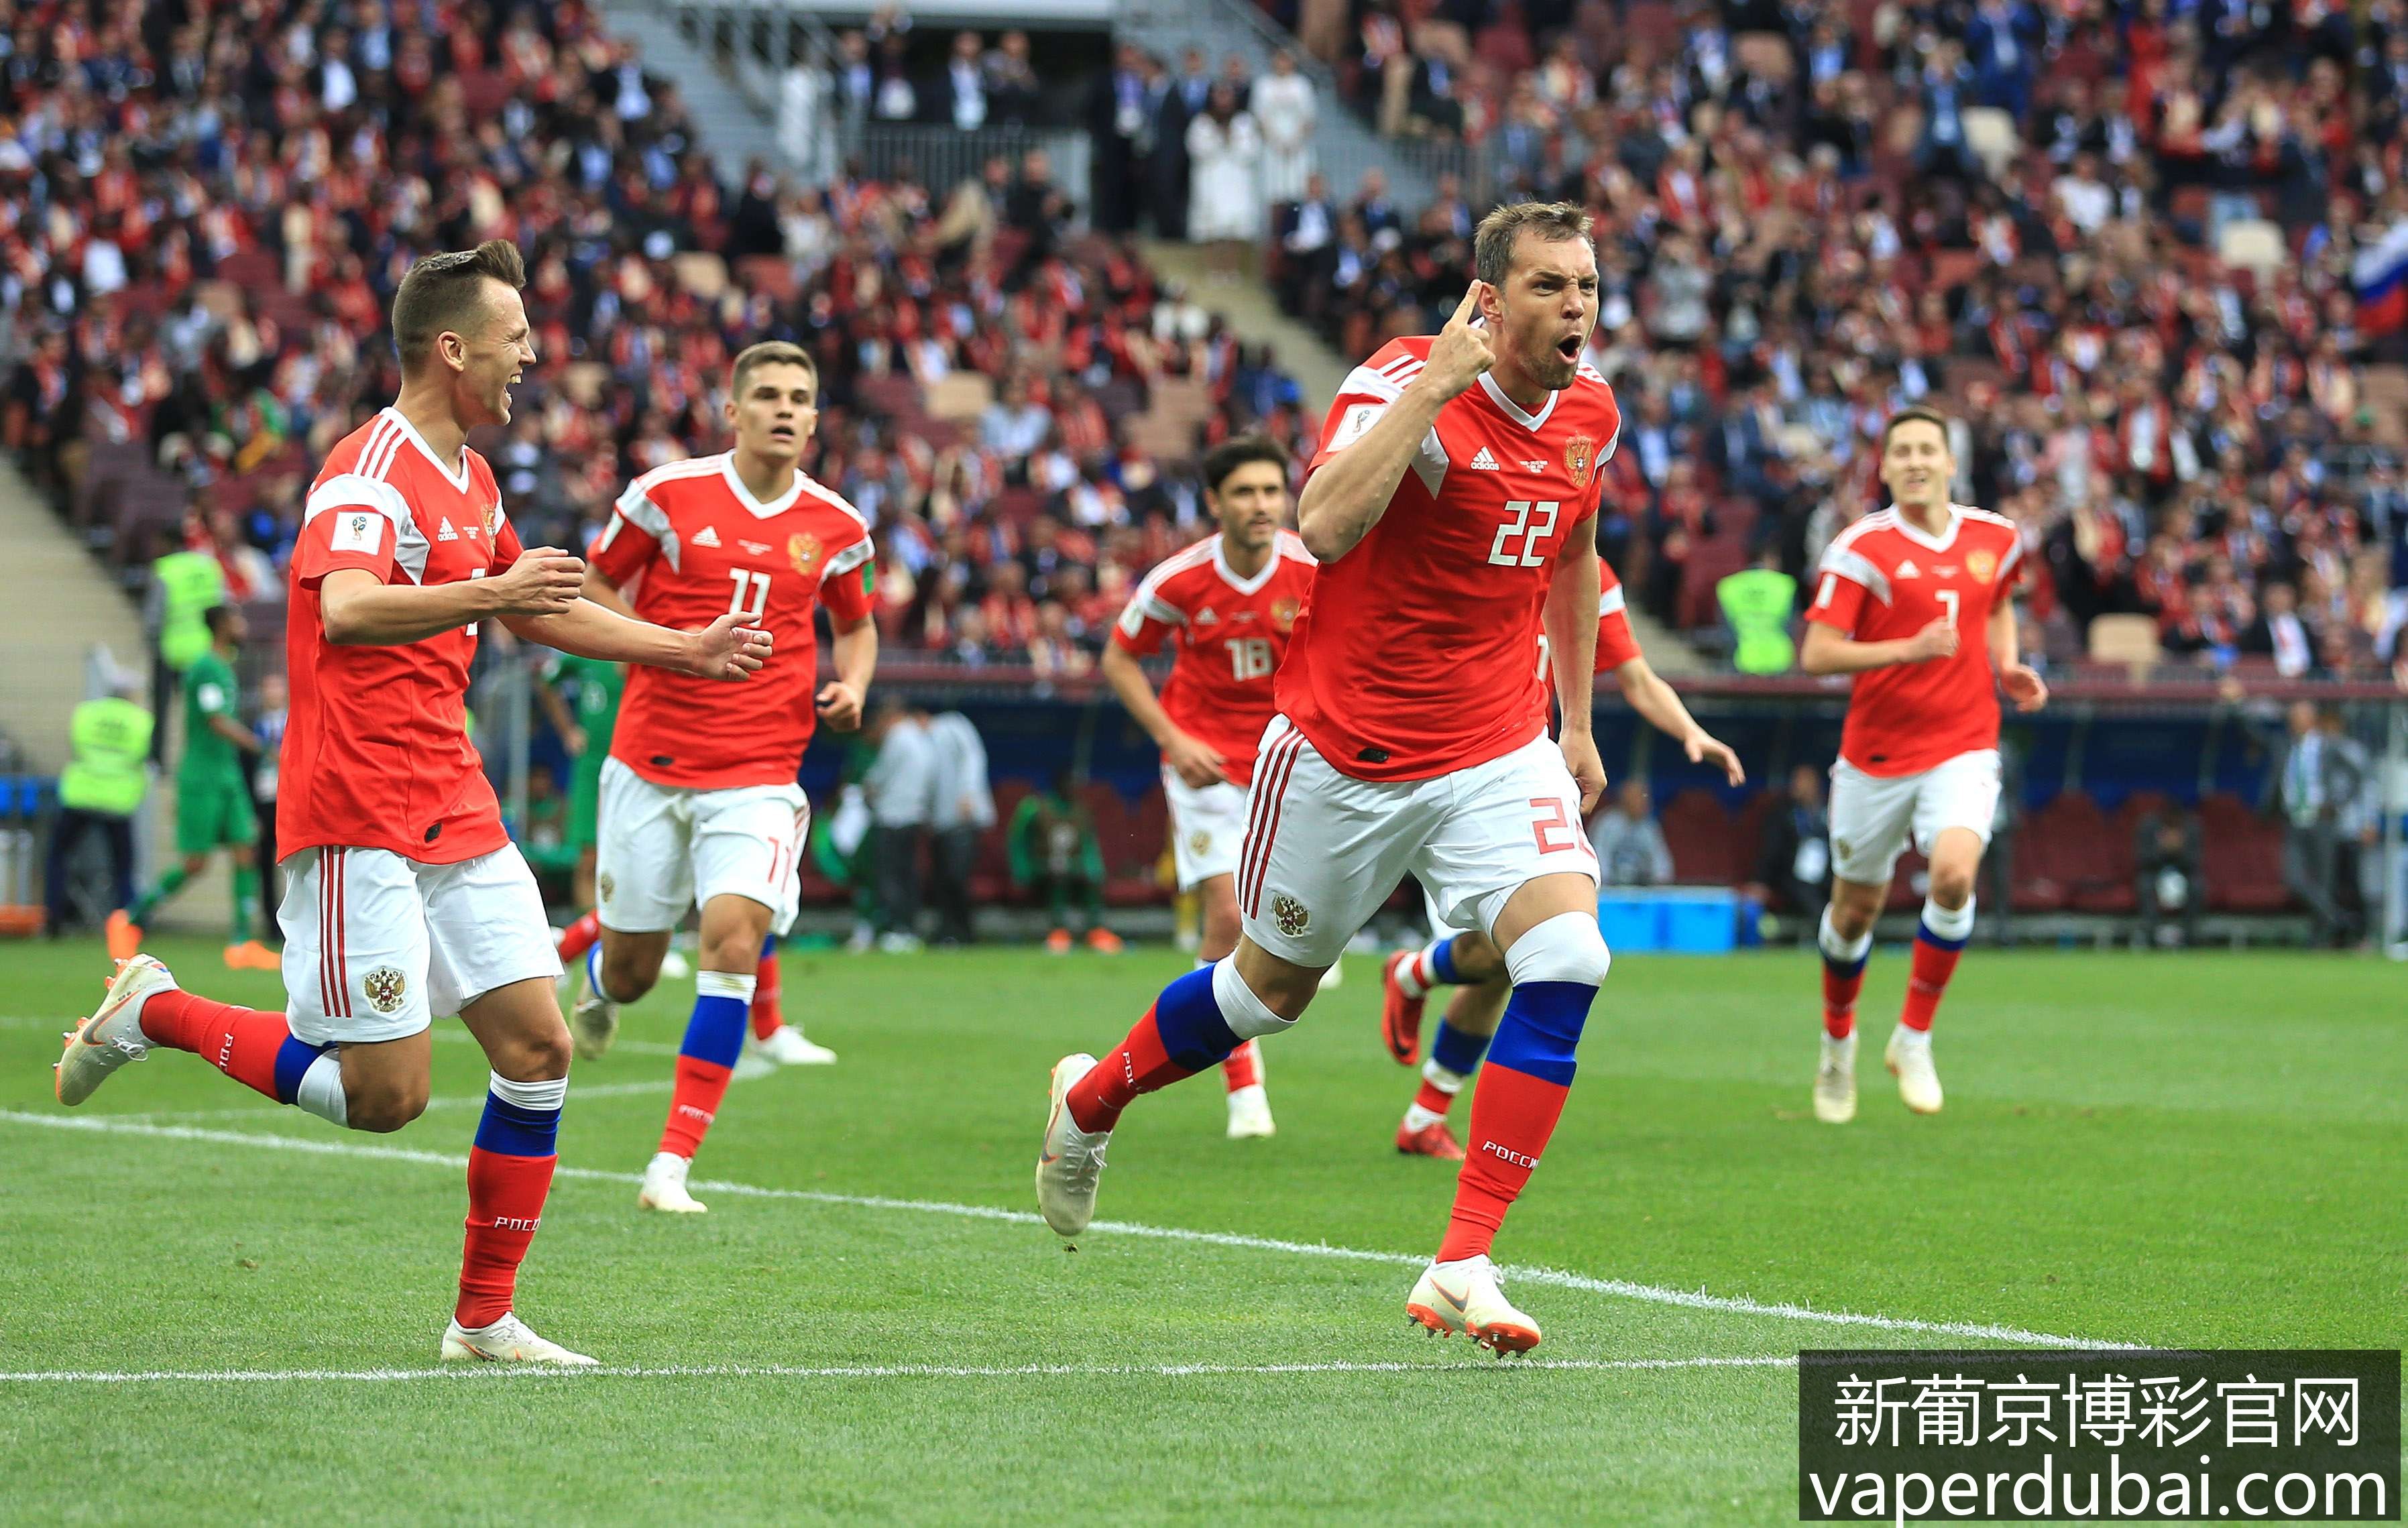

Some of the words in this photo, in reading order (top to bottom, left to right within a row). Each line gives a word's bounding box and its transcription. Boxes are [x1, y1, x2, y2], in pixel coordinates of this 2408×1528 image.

[1470, 461, 1500, 471] adidas
[437, 531, 459, 542] adidas
[1488, 500, 1560, 567] 22
[729, 567, 771, 628] 11
[1224, 638, 1272, 681] 18
